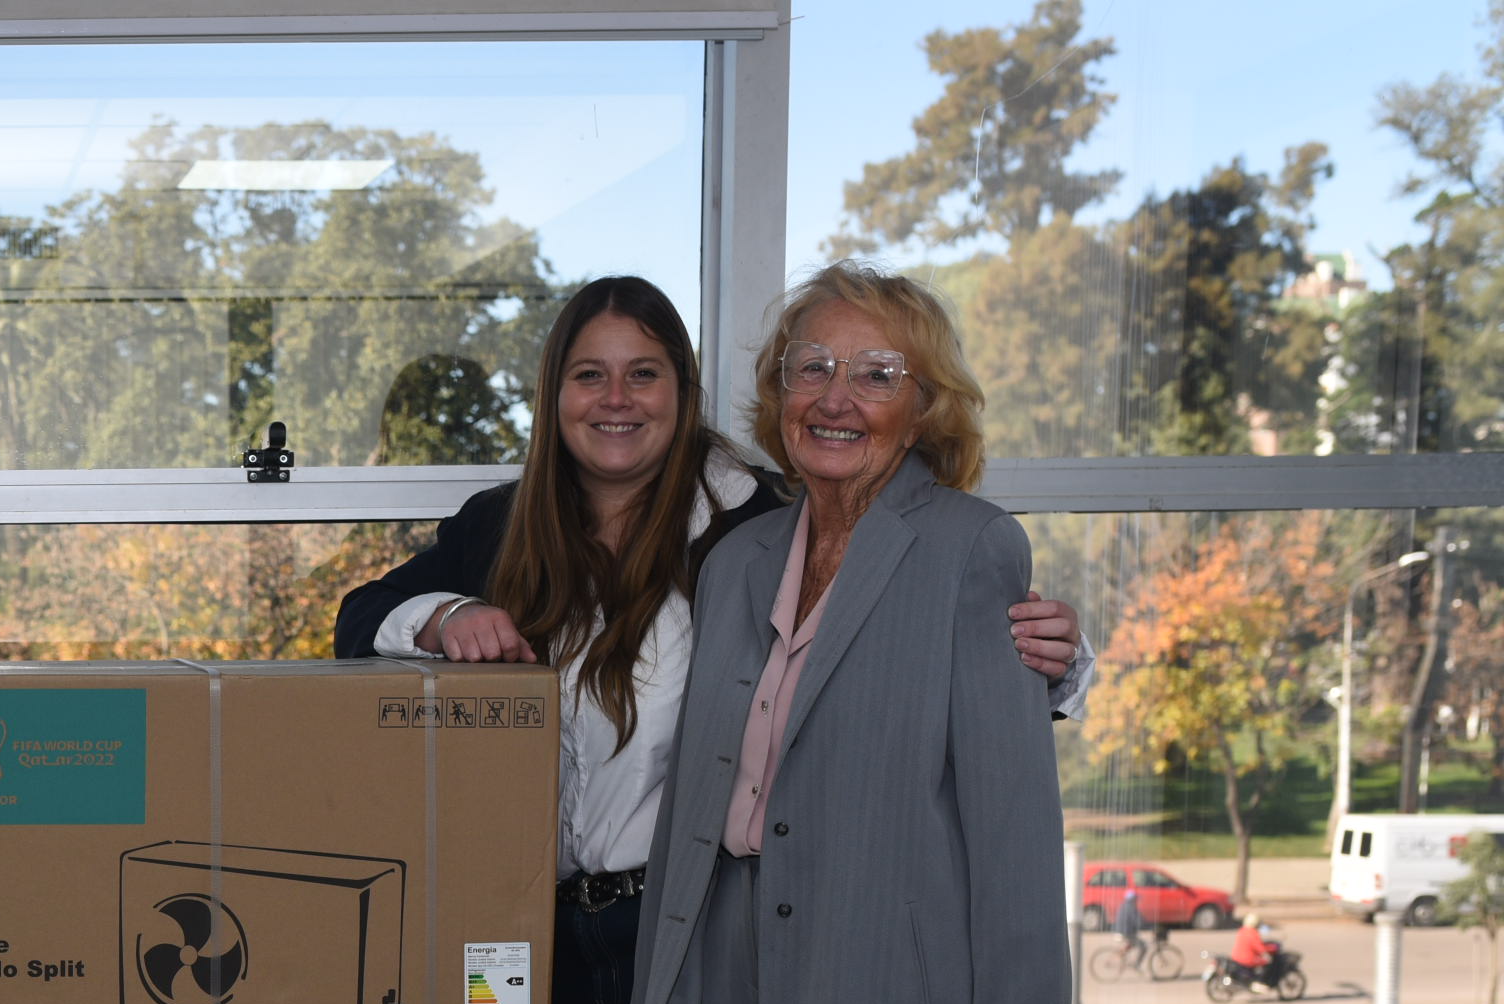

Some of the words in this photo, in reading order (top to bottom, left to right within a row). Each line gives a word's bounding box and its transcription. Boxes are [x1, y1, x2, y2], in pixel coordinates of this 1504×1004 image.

[13, 740, 43, 751] FIFA
[44, 740, 94, 751] WORLD
[96, 740, 122, 751] CUP
[27, 960, 85, 981] Split
